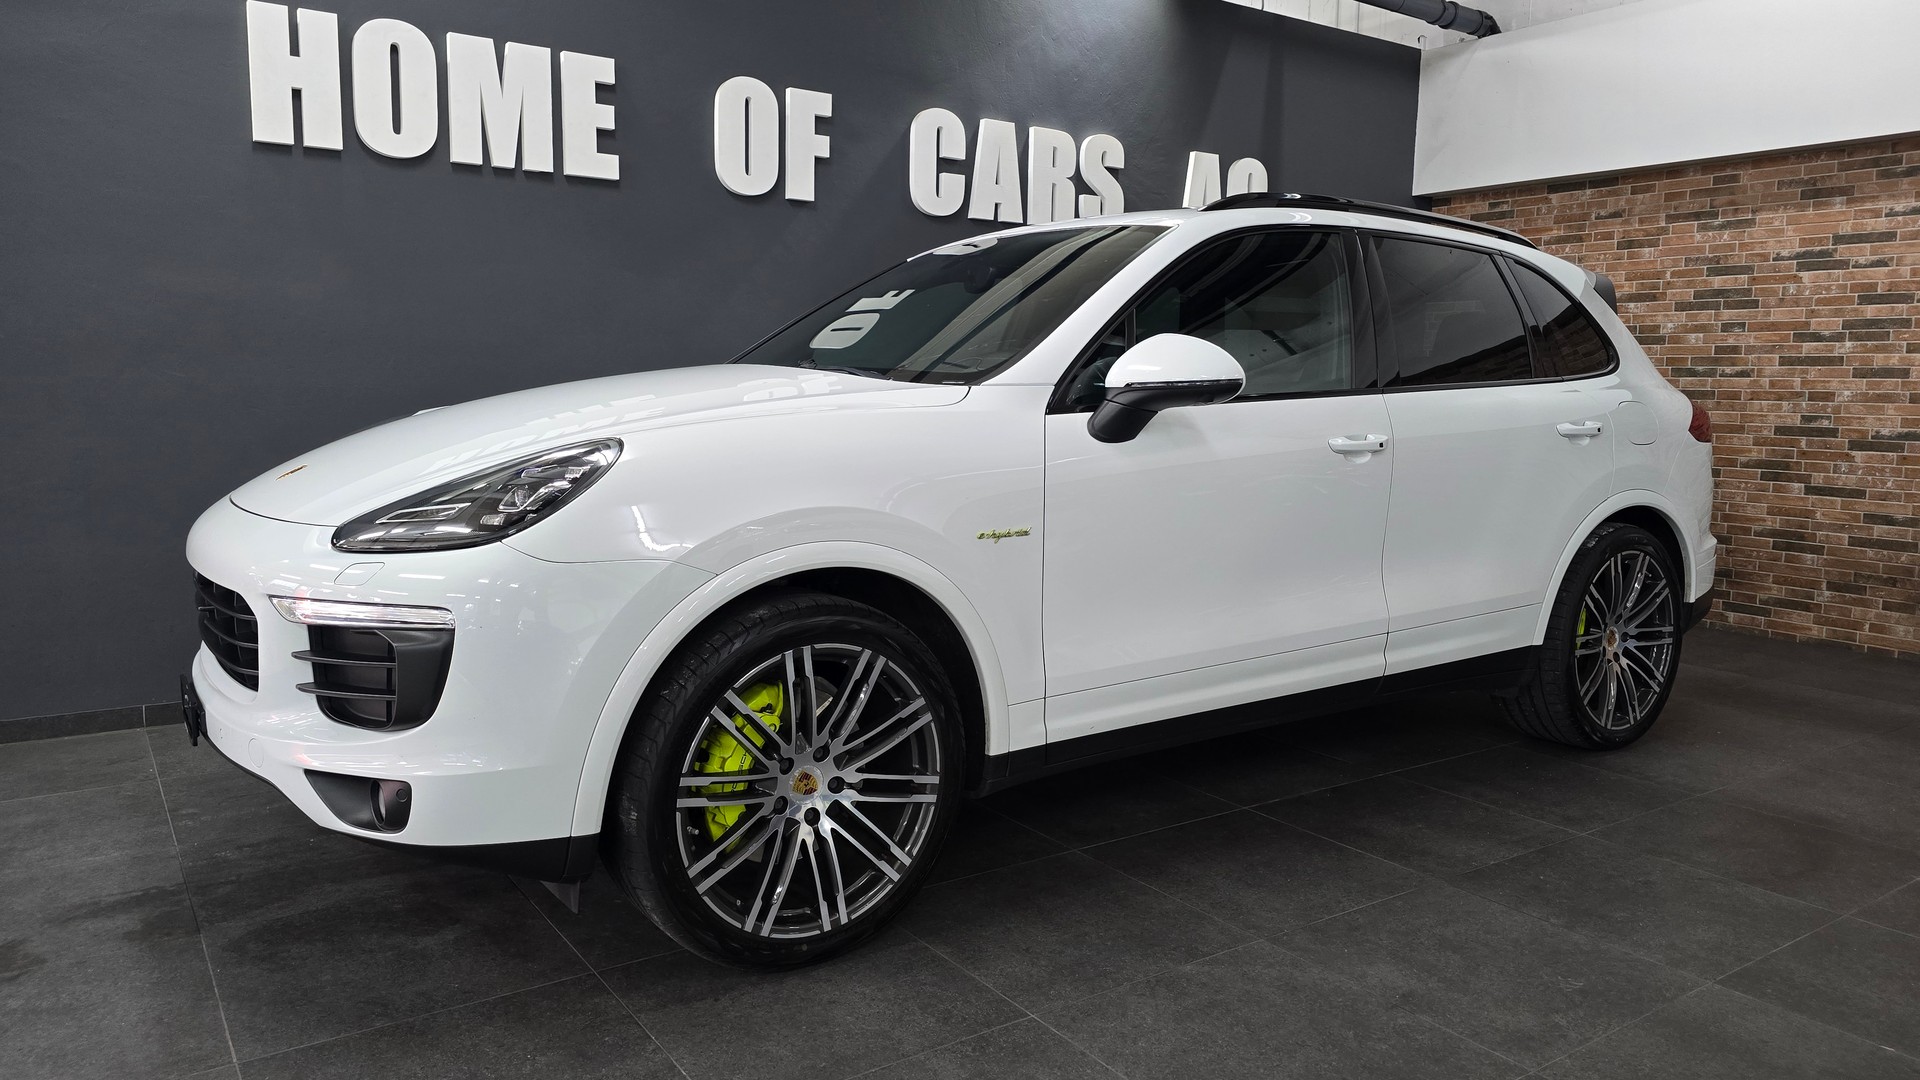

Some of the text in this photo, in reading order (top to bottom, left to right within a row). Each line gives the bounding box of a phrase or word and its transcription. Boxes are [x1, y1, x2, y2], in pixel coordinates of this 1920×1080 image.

[247, 0, 620, 181] HOME
[714, 76, 832, 202] OF
[909, 107, 1125, 224] CARS
